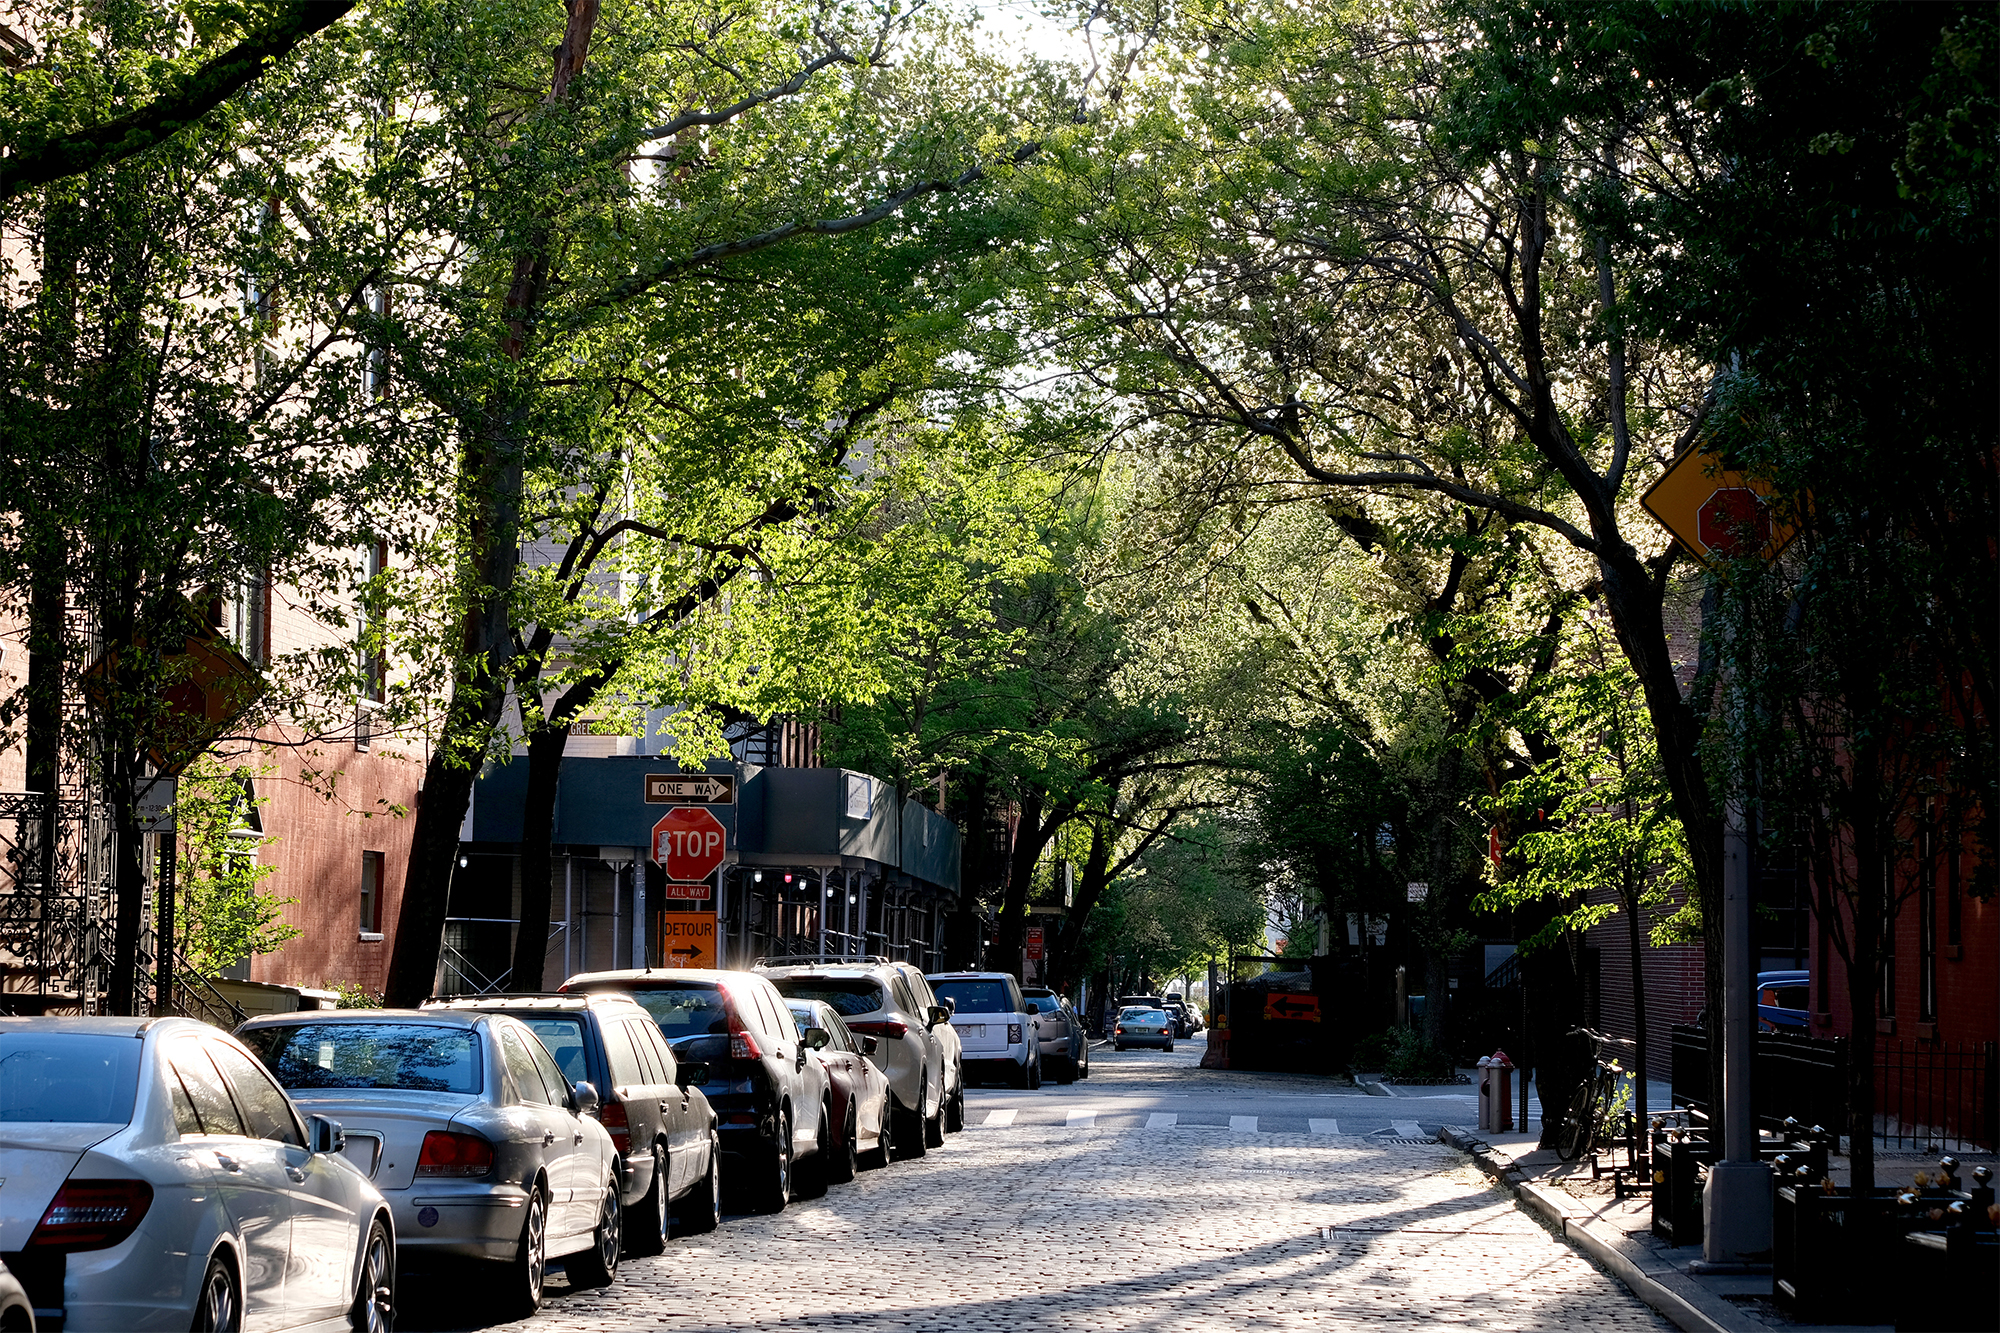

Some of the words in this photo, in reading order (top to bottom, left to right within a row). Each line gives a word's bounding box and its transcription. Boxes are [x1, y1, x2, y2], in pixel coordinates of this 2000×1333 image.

[658, 783, 683, 794] ONE
[694, 784, 720, 795] WAY
[671, 887, 686, 897] ALL
[689, 888, 705, 897] WAY
[665, 922, 712, 936] DETOUR
